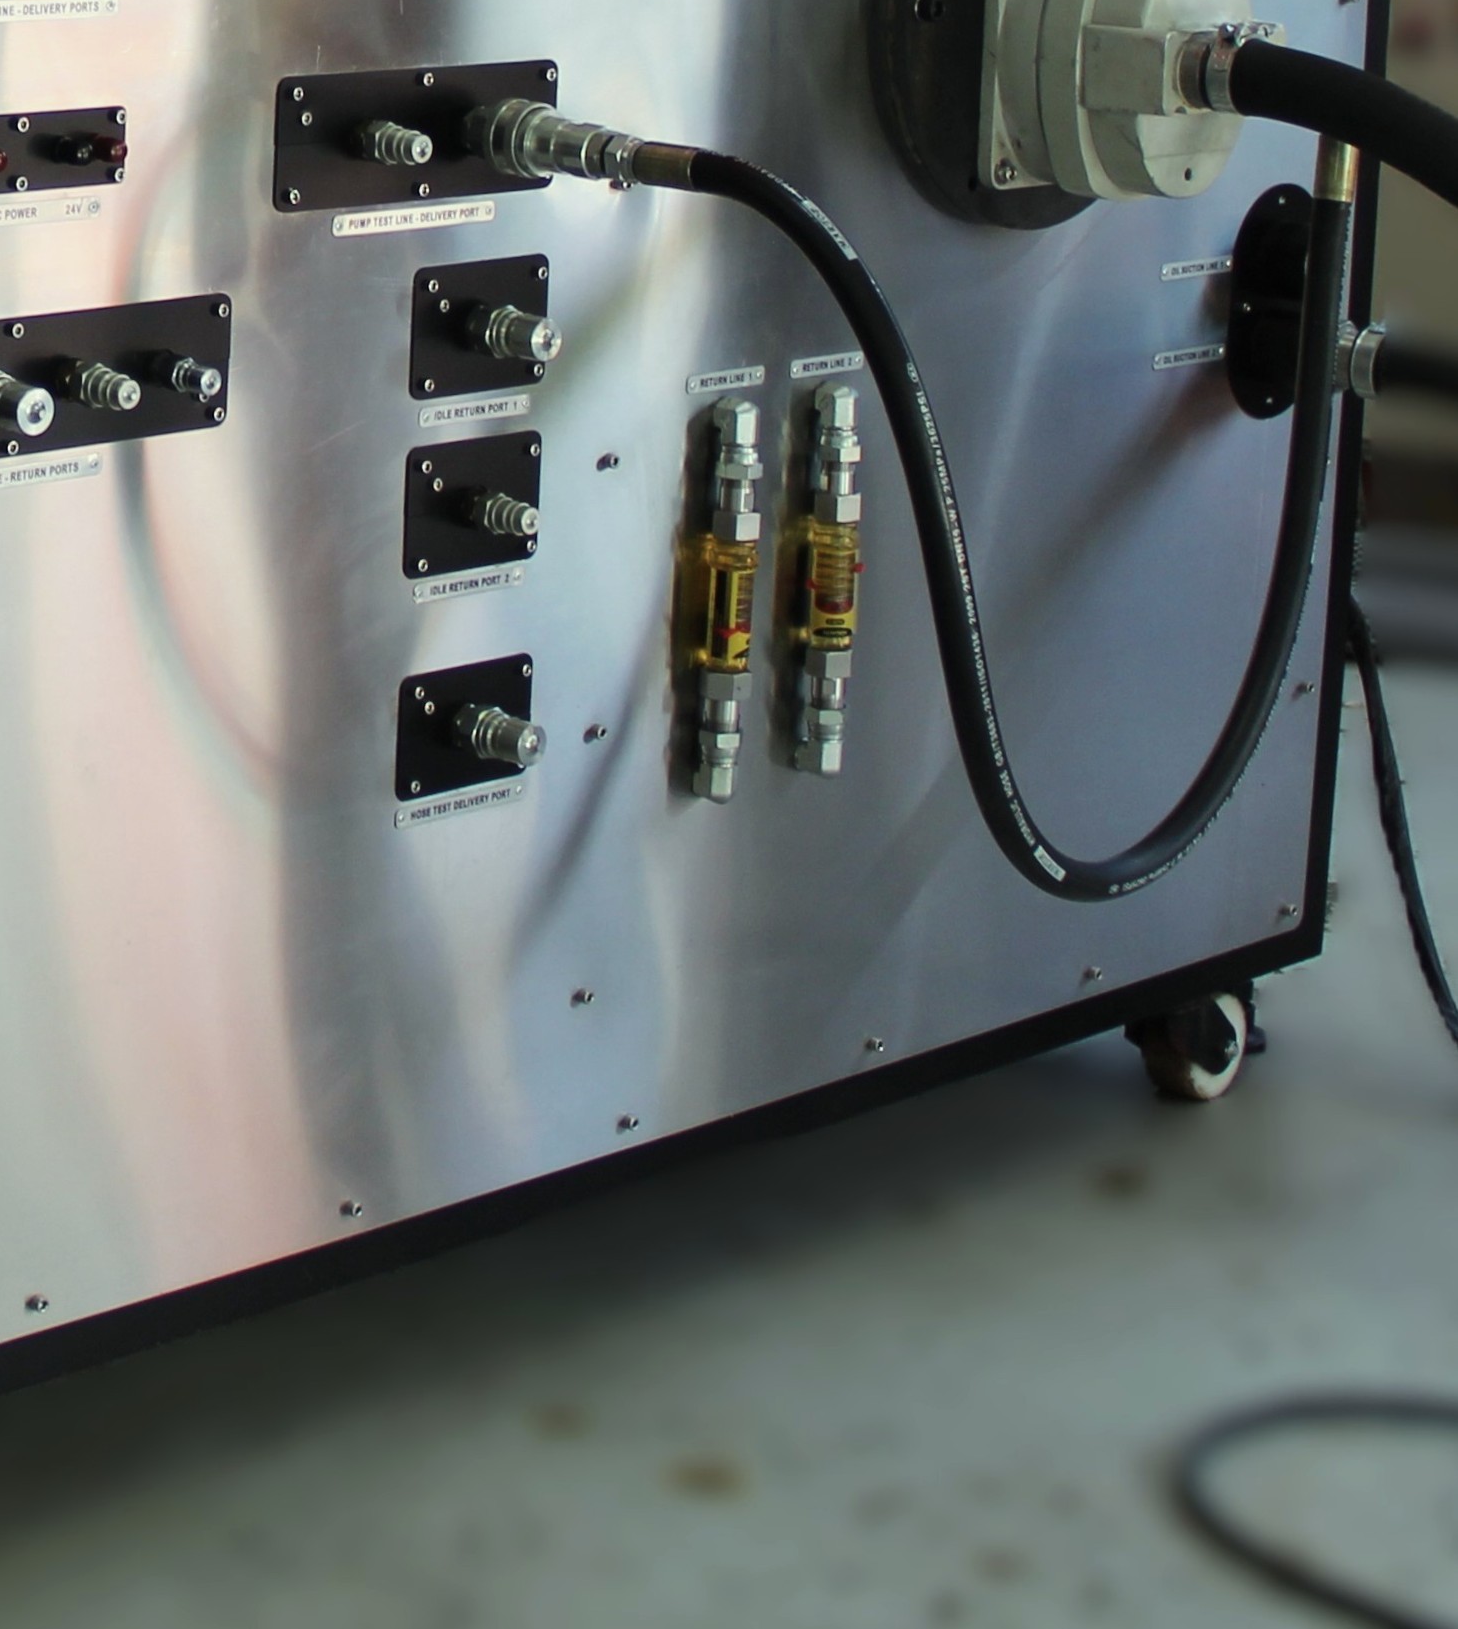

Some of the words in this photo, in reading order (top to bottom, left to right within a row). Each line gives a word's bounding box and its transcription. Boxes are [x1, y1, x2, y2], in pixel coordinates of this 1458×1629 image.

[22, 2, 66, 15] DELIVERY
[69, 0, 99, 13] PORTS
[5, 207, 37, 220] POWER
[65, 203, 81, 215] 24V
[348, 218, 371, 230] PUMP
[374, 216, 393, 227] TEST
[396, 214, 413, 225] LINE
[420, 210, 456, 223] DELIVERY
[459, 207, 480, 218] PORT
[802, 361, 828, 372] RETURN
[830, 358, 844, 369] LINE
[700, 375, 728, 388] RETURN
[729, 373, 745, 384] LINE
[434, 409, 451, 421] IDLE
[454, 405, 485, 418] RETURN
[488, 402, 508, 414] PORT
[10, 467, 46, 482] RETURN
[49, 462, 79, 476] PORTS
[430, 584, 447, 596] IDLE
[449, 579, 479, 592] RETURN
[481, 575, 501, 587] PORT
[410, 807, 430, 821] HOSE
[433, 803, 452, 815] TEST
[453, 794, 489, 811] DELIVERY
[492, 788, 510, 801] PORT
